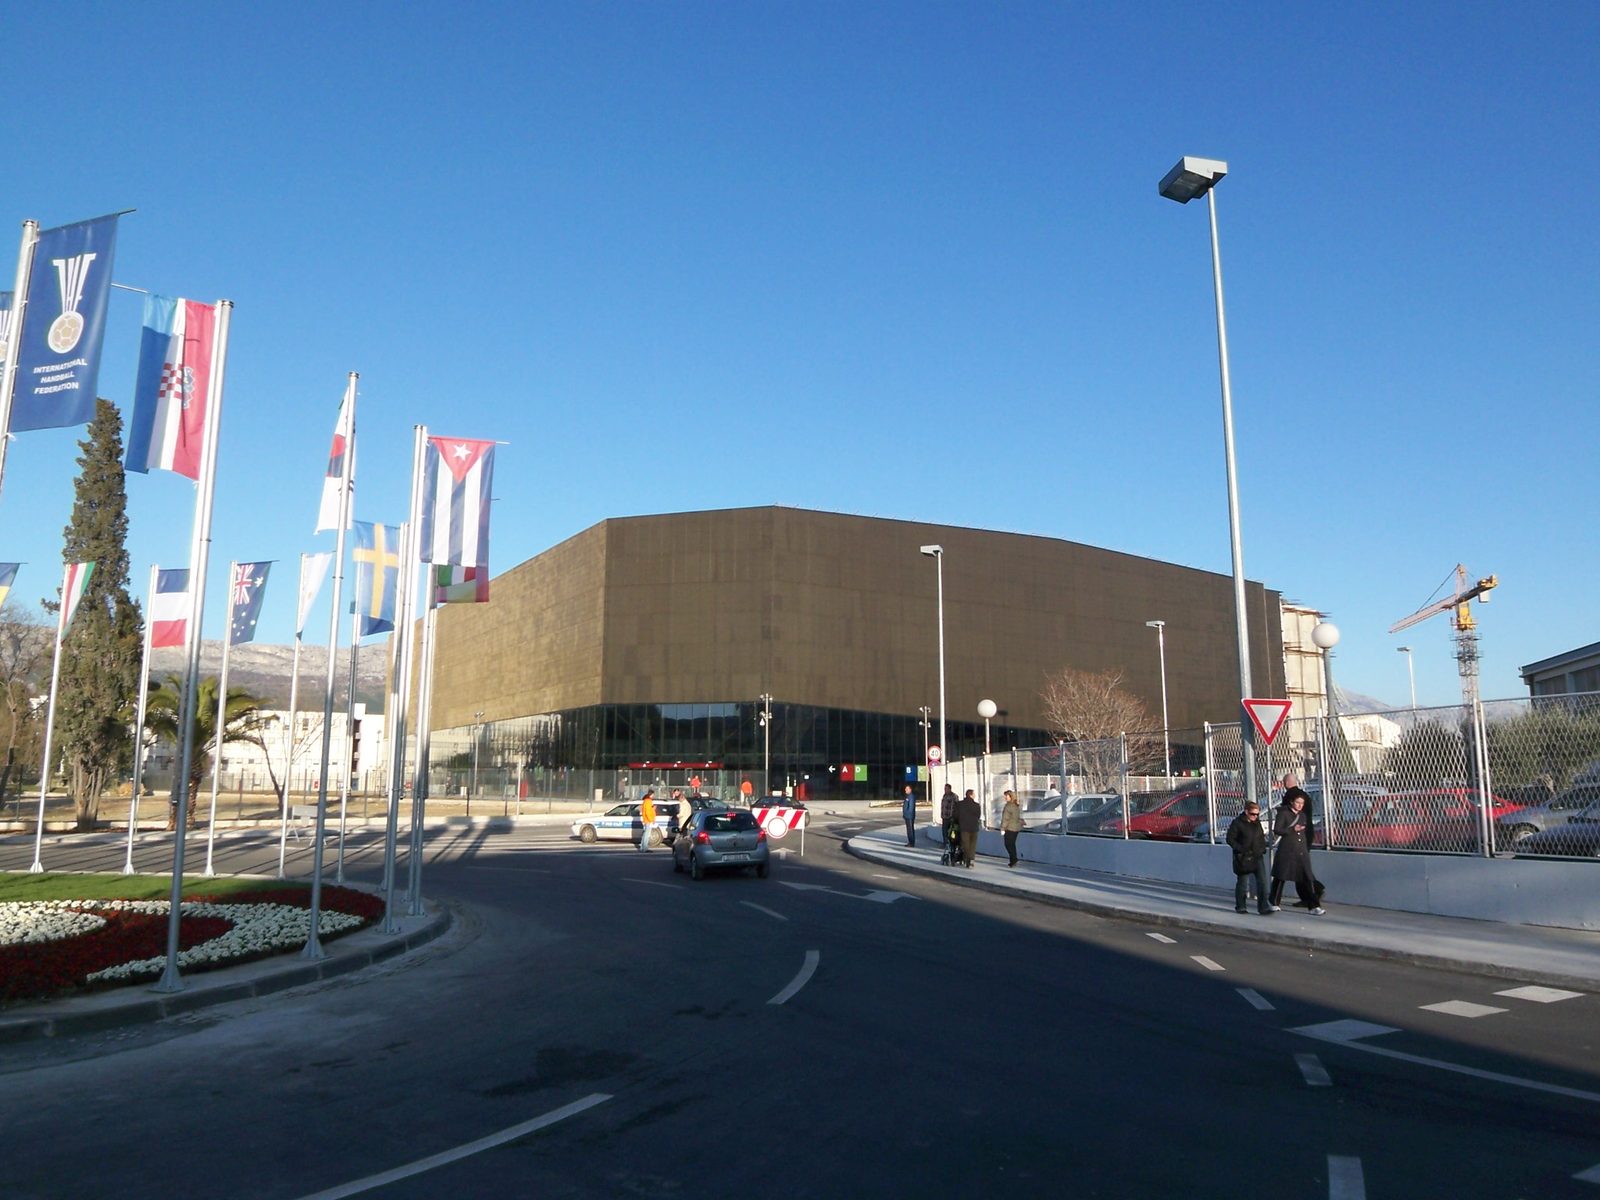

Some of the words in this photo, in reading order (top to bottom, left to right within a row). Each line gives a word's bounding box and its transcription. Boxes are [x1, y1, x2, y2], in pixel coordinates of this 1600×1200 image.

[33, 358, 88, 374] INTERNATIONAL
[40, 371, 75, 384] HANDBALL
[34, 382, 79, 394] FEDERATION
[930, 749, 939, 757] 40
[906, 766, 912, 774] B
